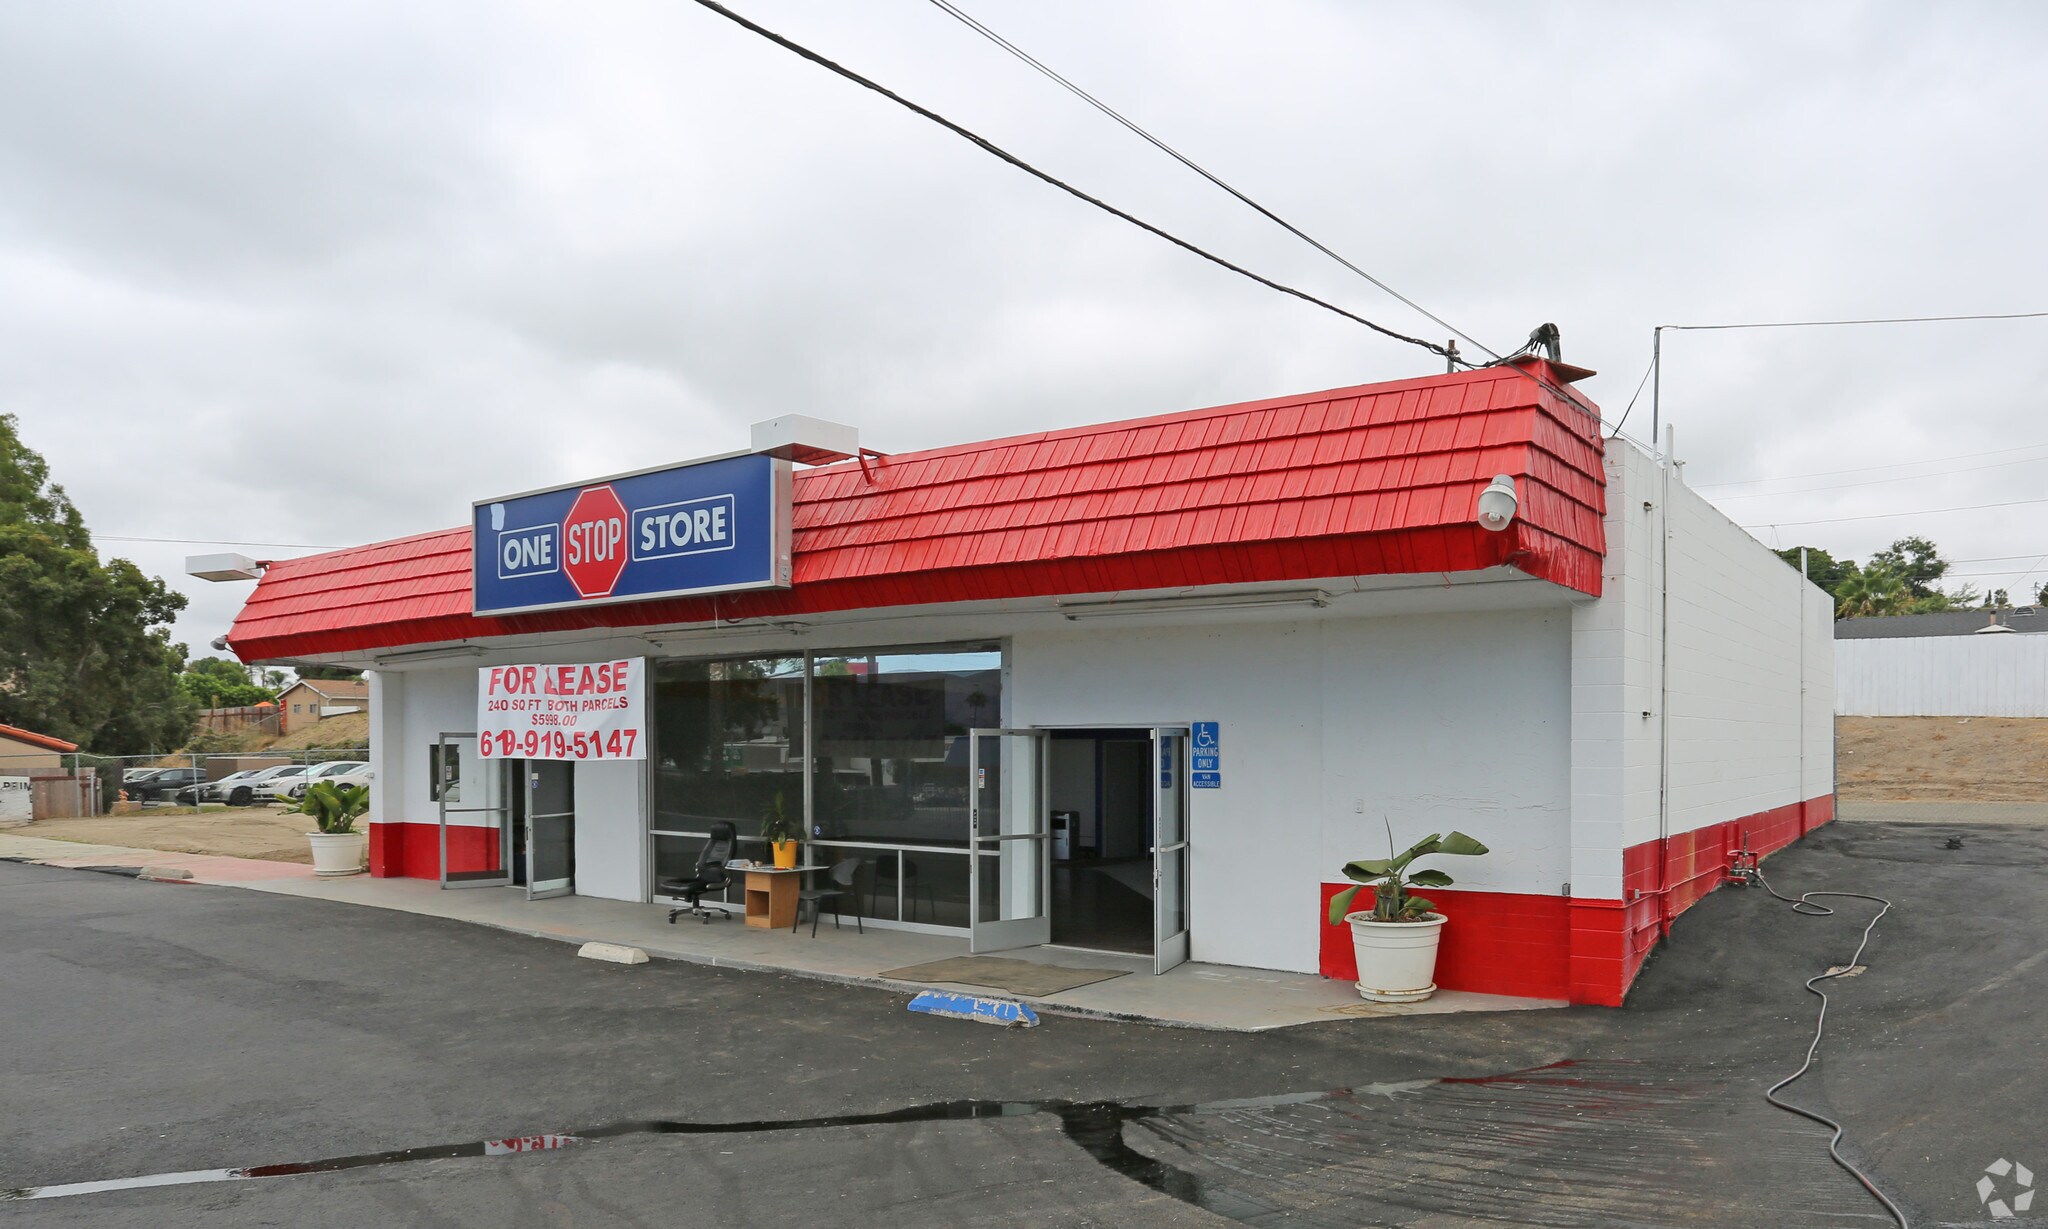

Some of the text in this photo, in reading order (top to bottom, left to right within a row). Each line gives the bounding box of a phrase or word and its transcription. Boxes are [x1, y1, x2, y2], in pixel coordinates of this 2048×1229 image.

[503, 506, 726, 570] ONE STOP STORE
[488, 661, 629, 696] FOR LEASE
[488, 696, 629, 712] 240 SQ FT BOTH PARCELS
[532, 713, 578, 727] $5998.00
[480, 729, 637, 759] 619-919-5147
[1193, 747, 1218, 757] PARKING
[1197, 758, 1213, 768] ONLY
